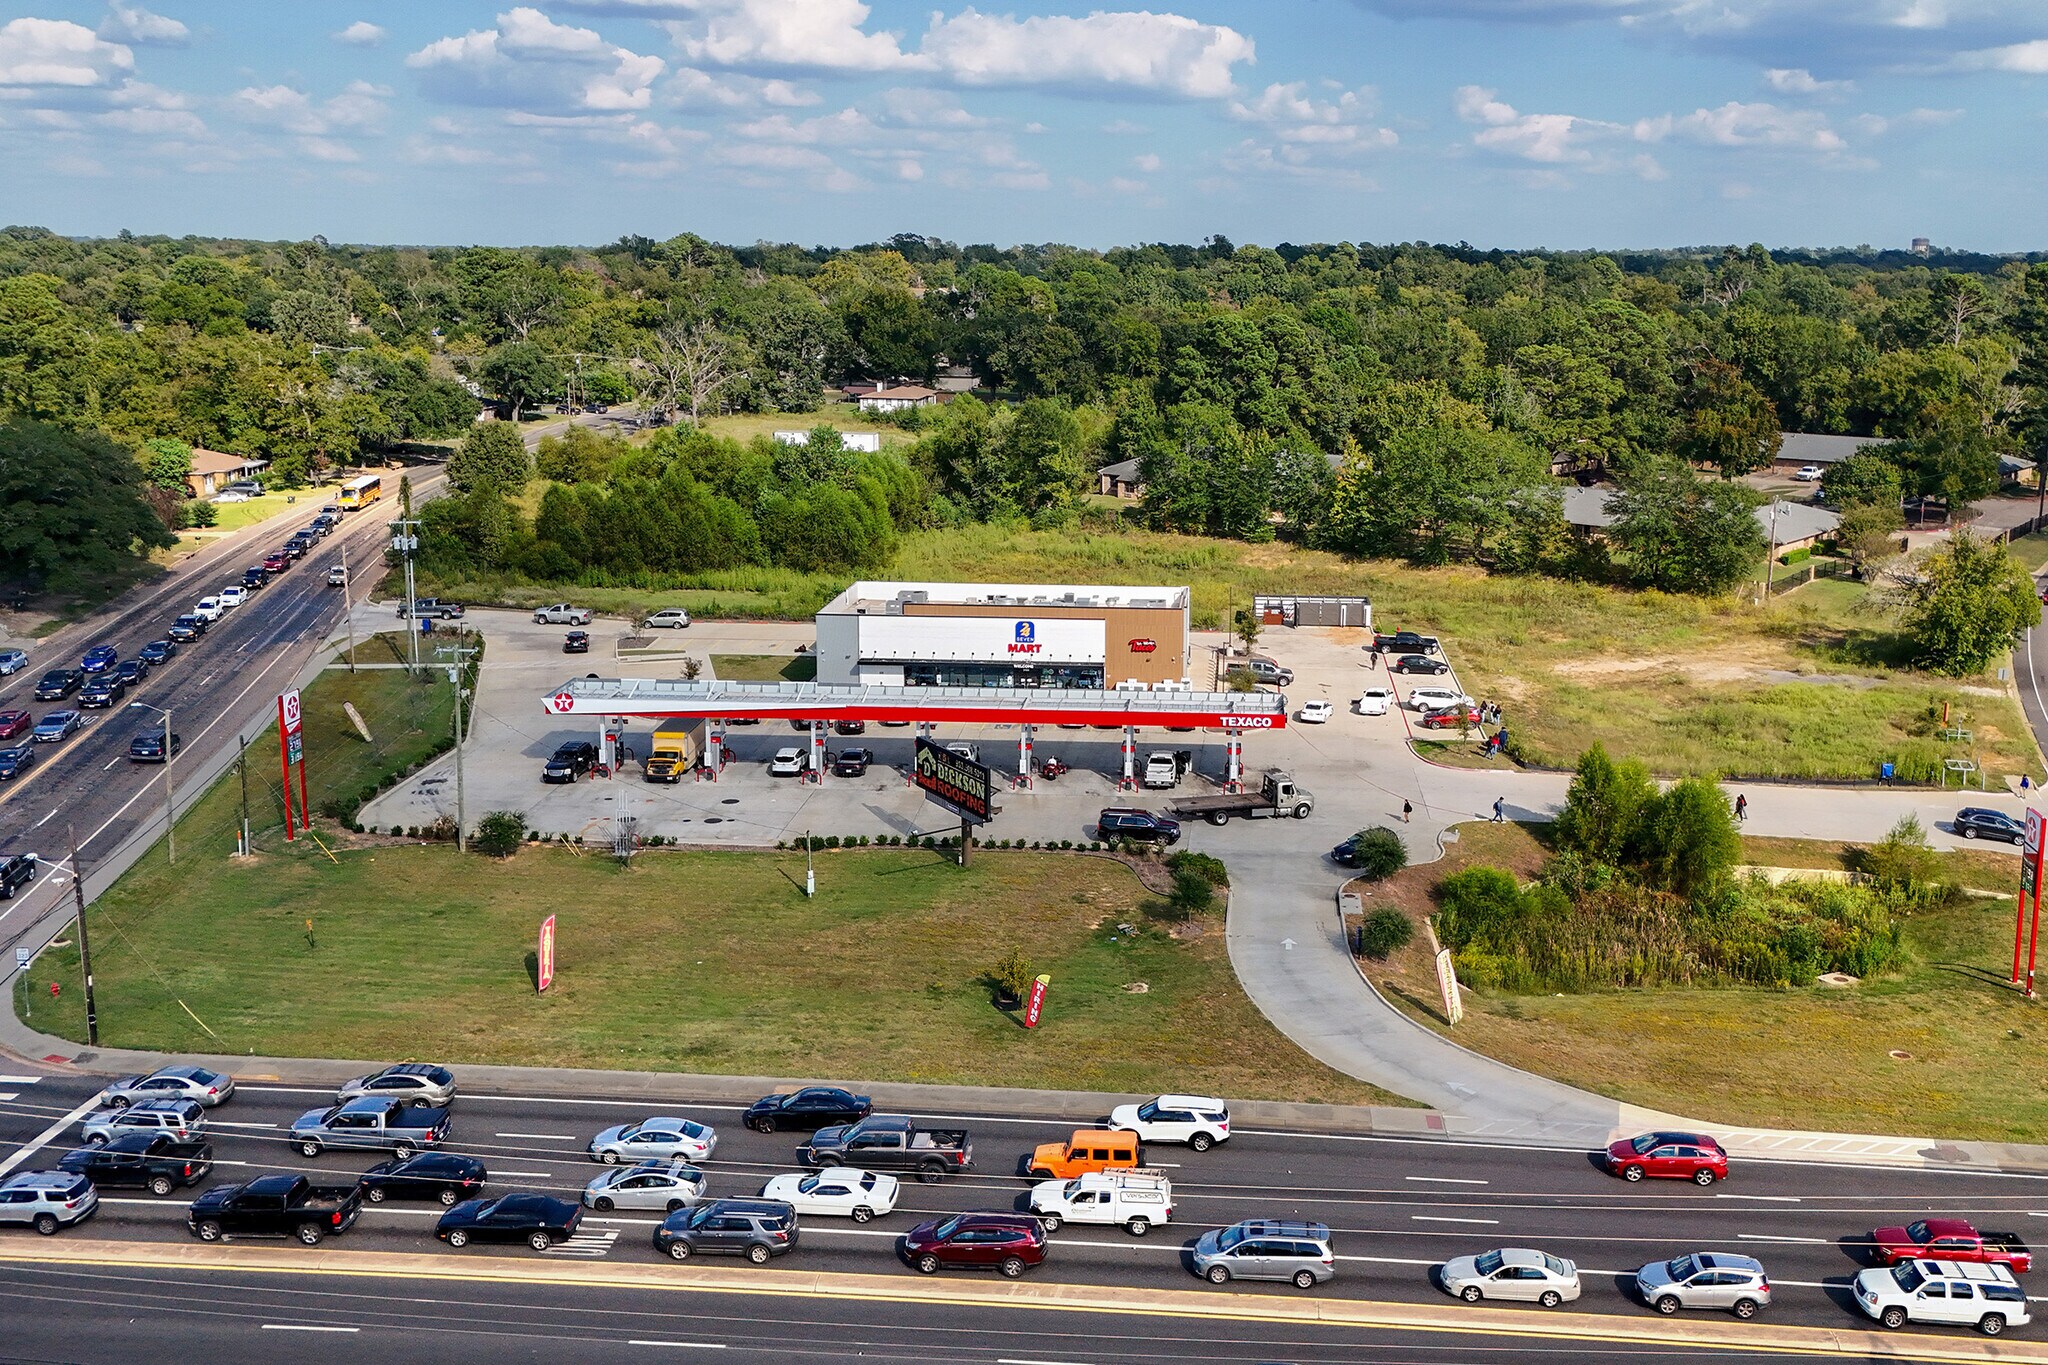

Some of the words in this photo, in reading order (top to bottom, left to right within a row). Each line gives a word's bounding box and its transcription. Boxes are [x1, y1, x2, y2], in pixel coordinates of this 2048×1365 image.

[1008, 643, 1042, 653] MART
[1219, 716, 1272, 727] TEXACO
[937, 763, 986, 800] DICKSON
[938, 781, 985, 814] ROOFING
[1030, 982, 1044, 1023] HIRING
